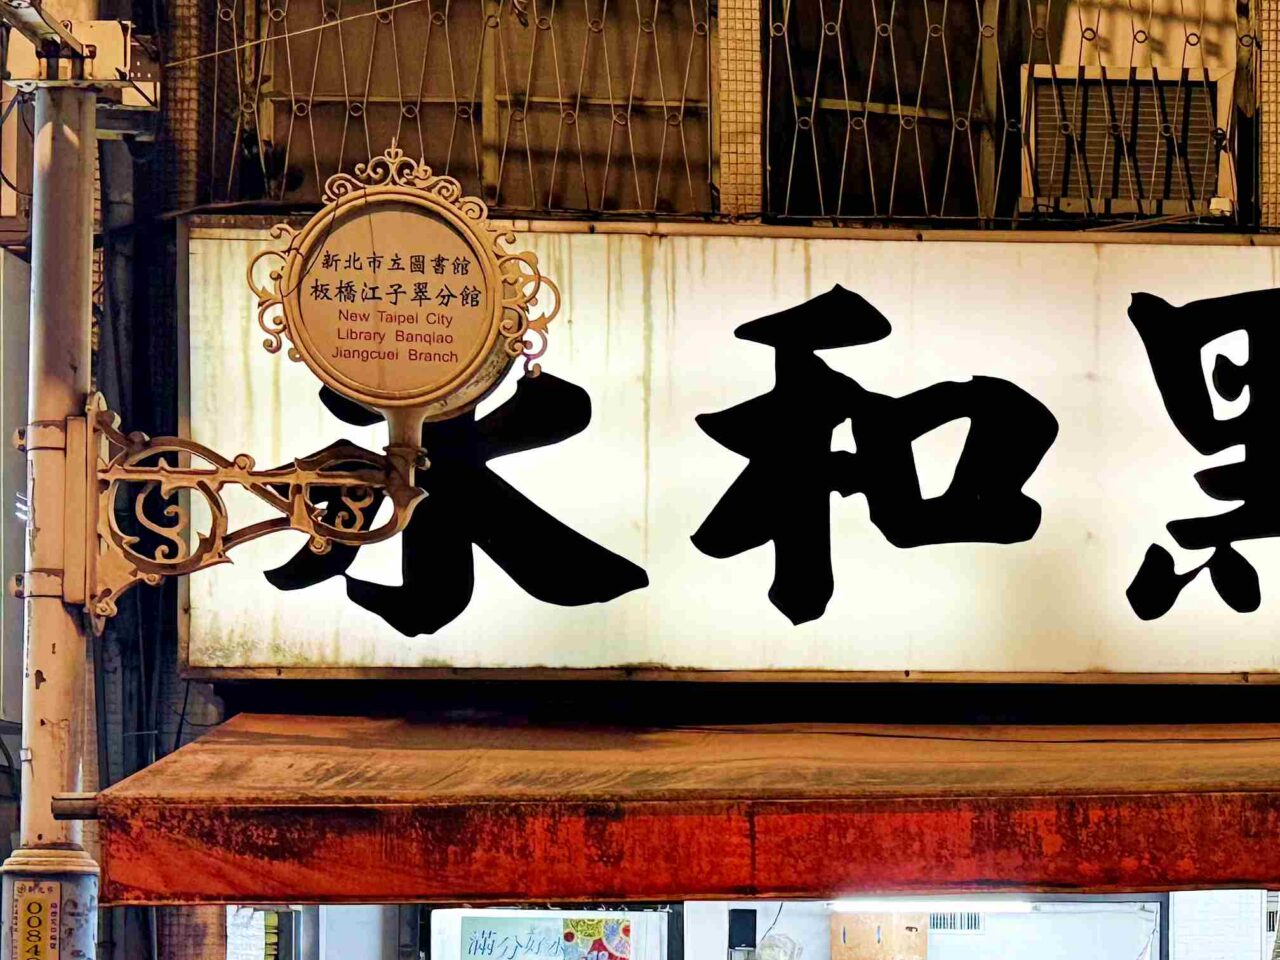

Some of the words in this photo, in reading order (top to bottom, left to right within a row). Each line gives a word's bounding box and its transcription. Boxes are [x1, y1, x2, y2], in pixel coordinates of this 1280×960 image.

[321, 250, 471, 276] 新北市立圖書館
[310, 278, 482, 308] 板橋江子翠分館
[338, 309, 370, 322] New
[377, 310, 419, 326] Taipei
[426, 312, 453, 327] City
[337, 328, 386, 344] Library
[395, 330, 453, 345] Banqiao
[331, 346, 399, 363] Jiangcuei
[408, 349, 459, 363] Branch
